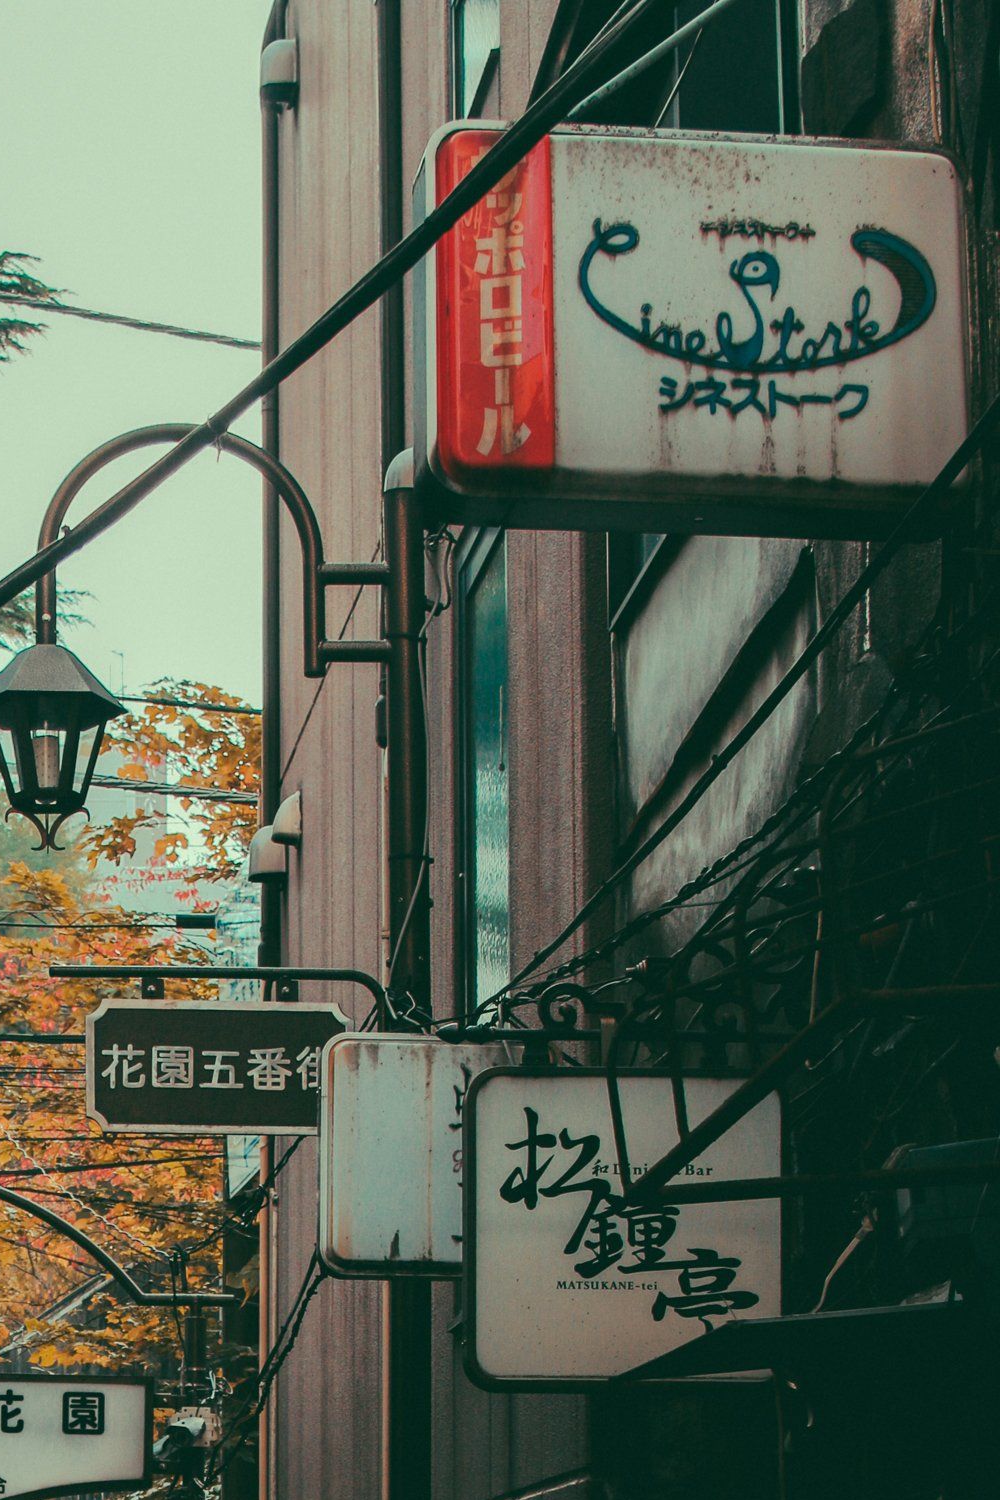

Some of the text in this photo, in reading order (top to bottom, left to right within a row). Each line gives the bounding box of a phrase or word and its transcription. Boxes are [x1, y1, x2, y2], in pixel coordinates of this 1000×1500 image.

[658, 376, 869, 419] シネストーク
[556, 1281, 658, 1291] MATSUKANE-tei
